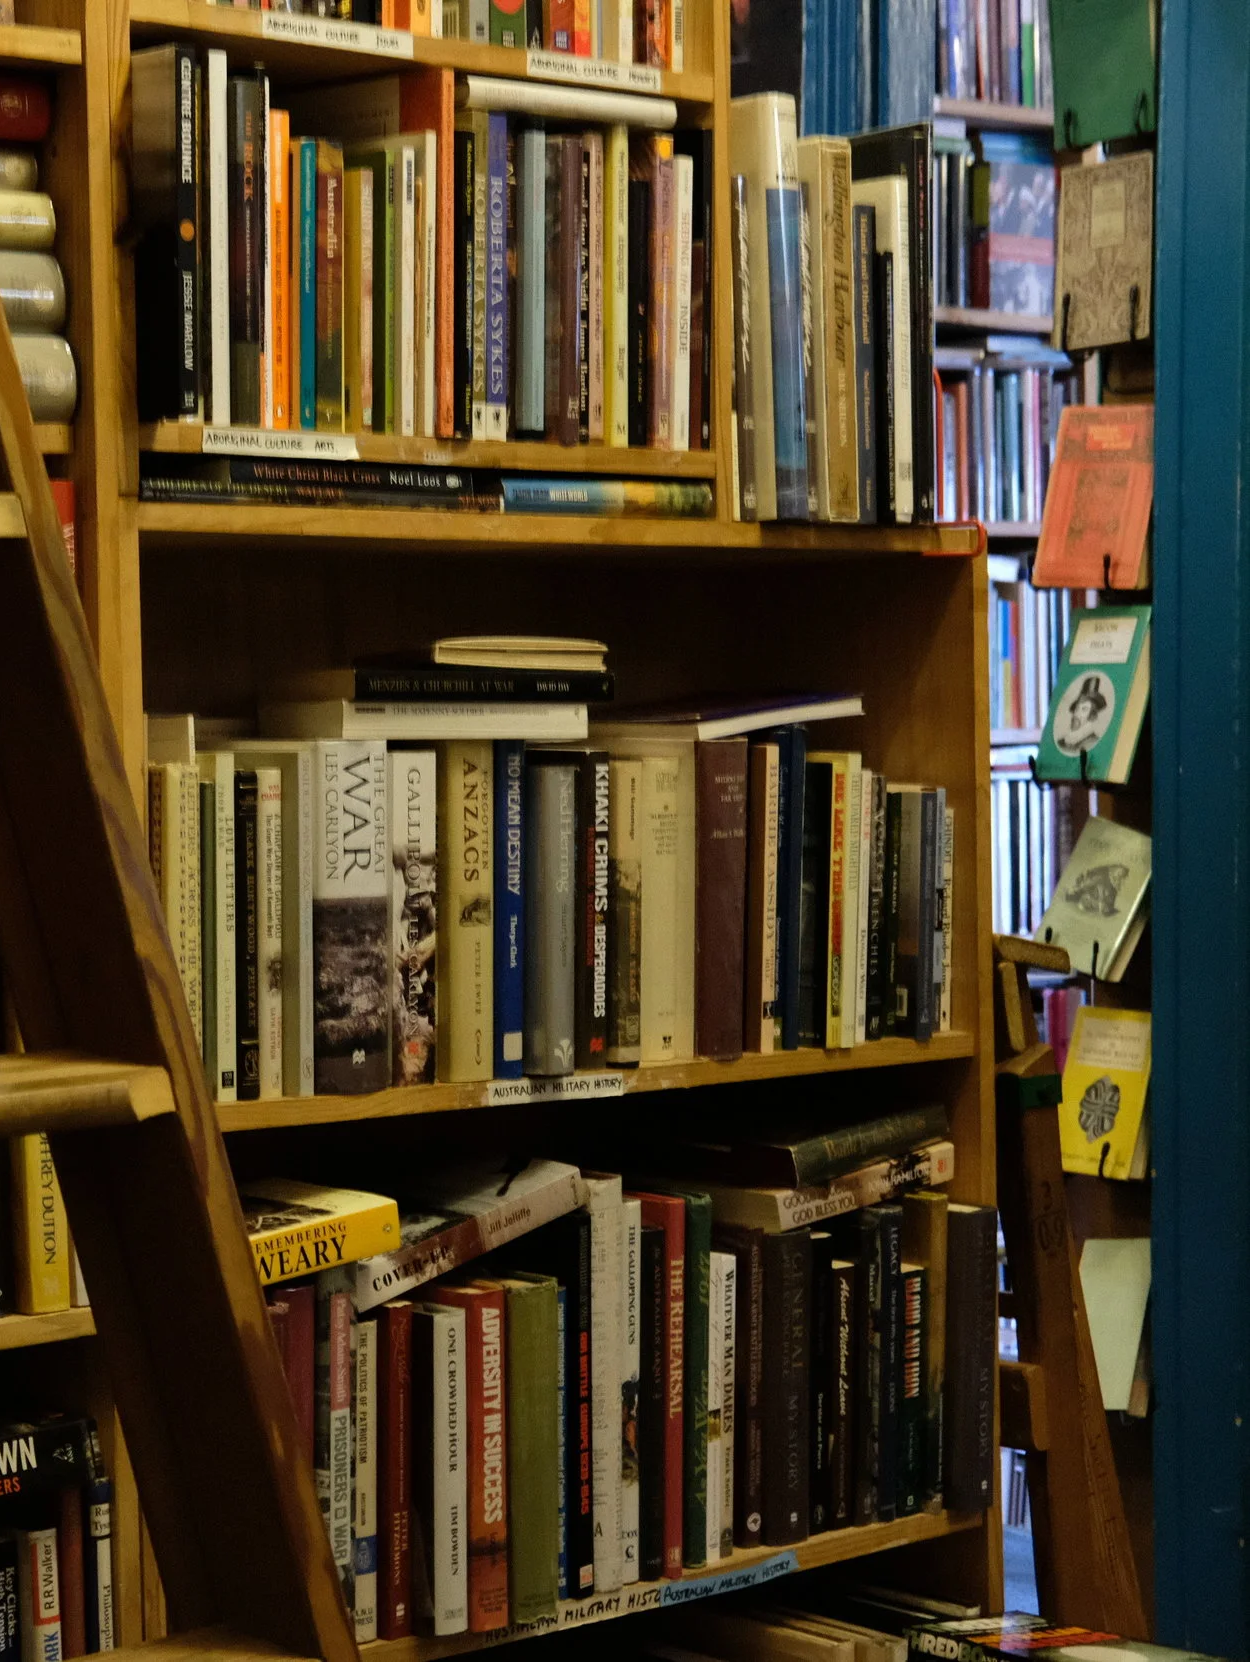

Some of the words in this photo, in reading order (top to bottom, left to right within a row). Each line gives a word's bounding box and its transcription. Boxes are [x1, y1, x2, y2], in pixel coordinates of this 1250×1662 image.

[474, 173, 486, 303] ROBERTA
[490, 176, 504, 306] ROBERTA
[182, 270, 194, 312] JESSE
[183, 311, 195, 372] MARLOW
[473, 307, 486, 394] SYKES
[491, 312, 503, 398] SYKES
[205, 432, 262, 452] ABORIGINAL
[264, 439, 304, 453] CULTURE
[253, 464, 287, 480] White
[288, 466, 318, 483] Christ
[321, 469, 351, 486] Black
[388, 471, 414, 489] Noel
[417, 473, 442, 489] Loos
[368, 677, 412, 694] MENZIES
[423, 678, 477, 696] CHURCHILL
[480, 680, 495, 695] AT
[495, 680, 515, 696] WAR
[325, 752, 338, 784] LES
[373, 752, 385, 799] THE
[507, 753, 520, 777] NO
[848, 774, 858, 802] THEY
[342, 753, 372, 885] WAR
[462, 756, 480, 884] ANZACS
[481, 769, 490, 871] FORGOTTEN
[507, 778, 520, 825] MEAN
[595, 762, 610, 833] KHAKI
[848, 803, 859, 838] DARED
[226, 817, 234, 857] LOVE
[274, 827, 283, 872] CHAPLAIN
[325, 788, 339, 881] CARLYON
[374, 804, 385, 880] GREAT
[406, 768, 421, 911] GALLIPOLI
[833, 808, 845, 853] LIKE
[944, 815, 952, 864] CHINDIT
[507, 825, 521, 897] DESTINY
[594, 837, 609, 914] CRIMS
[847, 839, 858, 892] MIGHTILY
[226, 863, 235, 934] LETTERS
[266, 896, 274, 923] Kenneth
[274, 891, 283, 939] GALLIPOLI
[942, 879, 952, 923] Richard
[409, 917, 420, 950] LES
[509, 913, 519, 946] Thorpe
[510, 945, 519, 970] Clark
[593, 924, 608, 1019] DESPERADOES
[941, 962, 952, 998] James
[407, 953, 420, 1037] CARLYON
[493, 1084, 546, 1099] AUSTRALIAN
[552, 1080, 590, 1094] MILITARY
[593, 1076, 623, 1091] HISTORY
[890, 1164, 931, 1188] HAMILTON
[503, 1206, 532, 1231] Jolliffe
[792, 1208, 814, 1225] GOD
[815, 1200, 837, 1218] BLESS
[838, 1195, 857, 1210] YOU
[254, 1221, 349, 1256] EMEMBERING
[628, 1225, 636, 1249] THE
[889, 1226, 899, 1279] LEGACY
[372, 1243, 452, 1293] COVER-UP
[628, 1250, 637, 1313] GALLOPING
[669, 1258, 684, 1300] THE
[336, 1298, 348, 1330] Patsy
[723, 1269, 735, 1342] WHATEVER
[791, 1251, 805, 1369] GENERAL
[838, 1276, 850, 1323] Absent
[359, 1332, 368, 1350] THE
[447, 1327, 456, 1357] ONE
[628, 1314, 637, 1346] GUNS
[838, 1324, 850, 1375] Without
[903, 1327, 921, 1361] AND
[336, 1331, 348, 1404] Adam-Smith
[359, 1353, 368, 1392] POLITICS
[481, 1306, 502, 1411] ADVERSITY
[669, 1301, 685, 1420] REHEARSAL
[723, 1345, 735, 1378] MAN
[359, 1395, 368, 1407] OF
[447, 1359, 458, 1430] CROWDED
[723, 1382, 734, 1436] DARES
[789, 1393, 799, 1422] MY
[838, 1377, 850, 1417] Leave
[358, 1411, 368, 1464] PATRIOTISM
[483, 1411, 503, 1435] IN
[334, 1413, 349, 1503] PRISONERS
[449, 1433, 459, 1473] HOUR
[788, 1429, 798, 1491] STORY
[483, 1434, 503, 1526] SUCCESS
[401, 1510, 409, 1552] PETER
[450, 1504, 459, 1527] TIM
[335, 1522, 349, 1561] WAR
[393, 1511, 402, 1587] FITZSIMONS
[450, 1528, 459, 1577] BOWDEN
[5, 1565, 16, 1591] Key
[42, 1543, 57, 1611] R.R.Walker
[662, 1580, 715, 1603] AUSTRALIAN
[718, 1572, 757, 1593] MILITARY
[760, 1559, 791, 1582] HISTORY
[6, 1592, 17, 1639] Clicks
[563, 1597, 621, 1623] MILITARY
